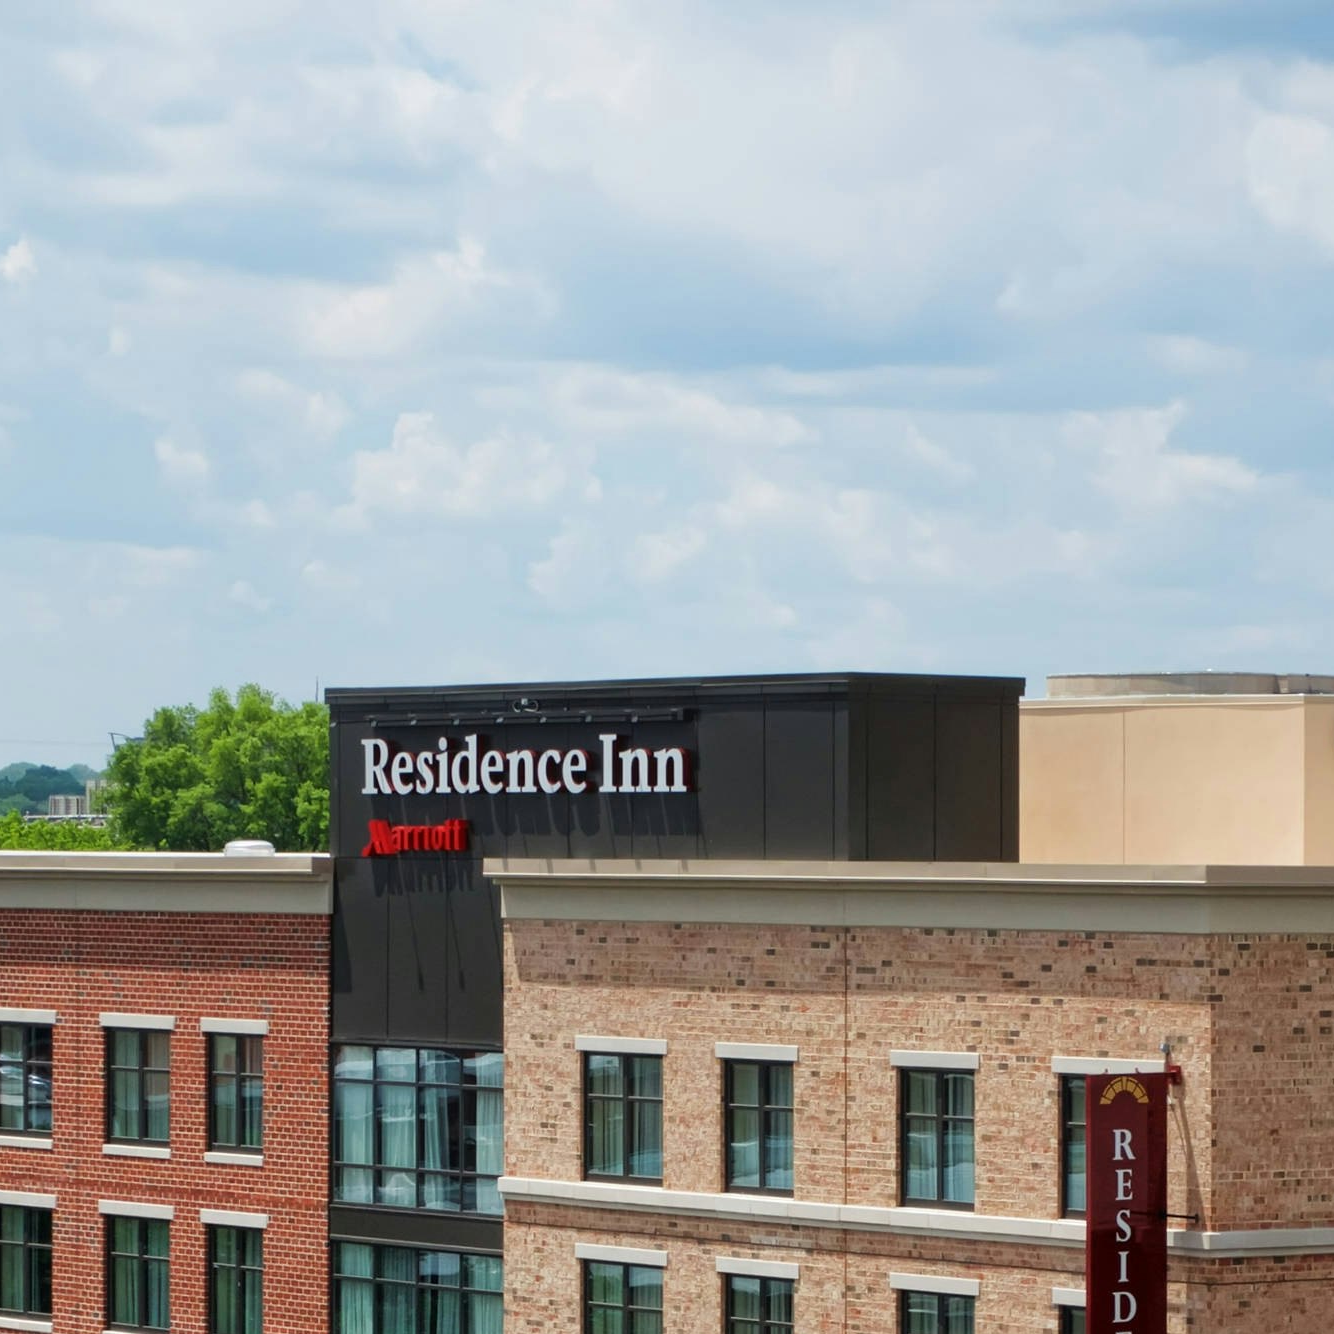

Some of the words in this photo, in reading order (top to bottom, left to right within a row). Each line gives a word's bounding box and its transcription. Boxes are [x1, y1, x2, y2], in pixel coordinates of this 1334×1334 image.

[361, 733, 590, 795] Residence
[598, 733, 689, 793] Inn
[361, 818, 469, 857] Marriott
